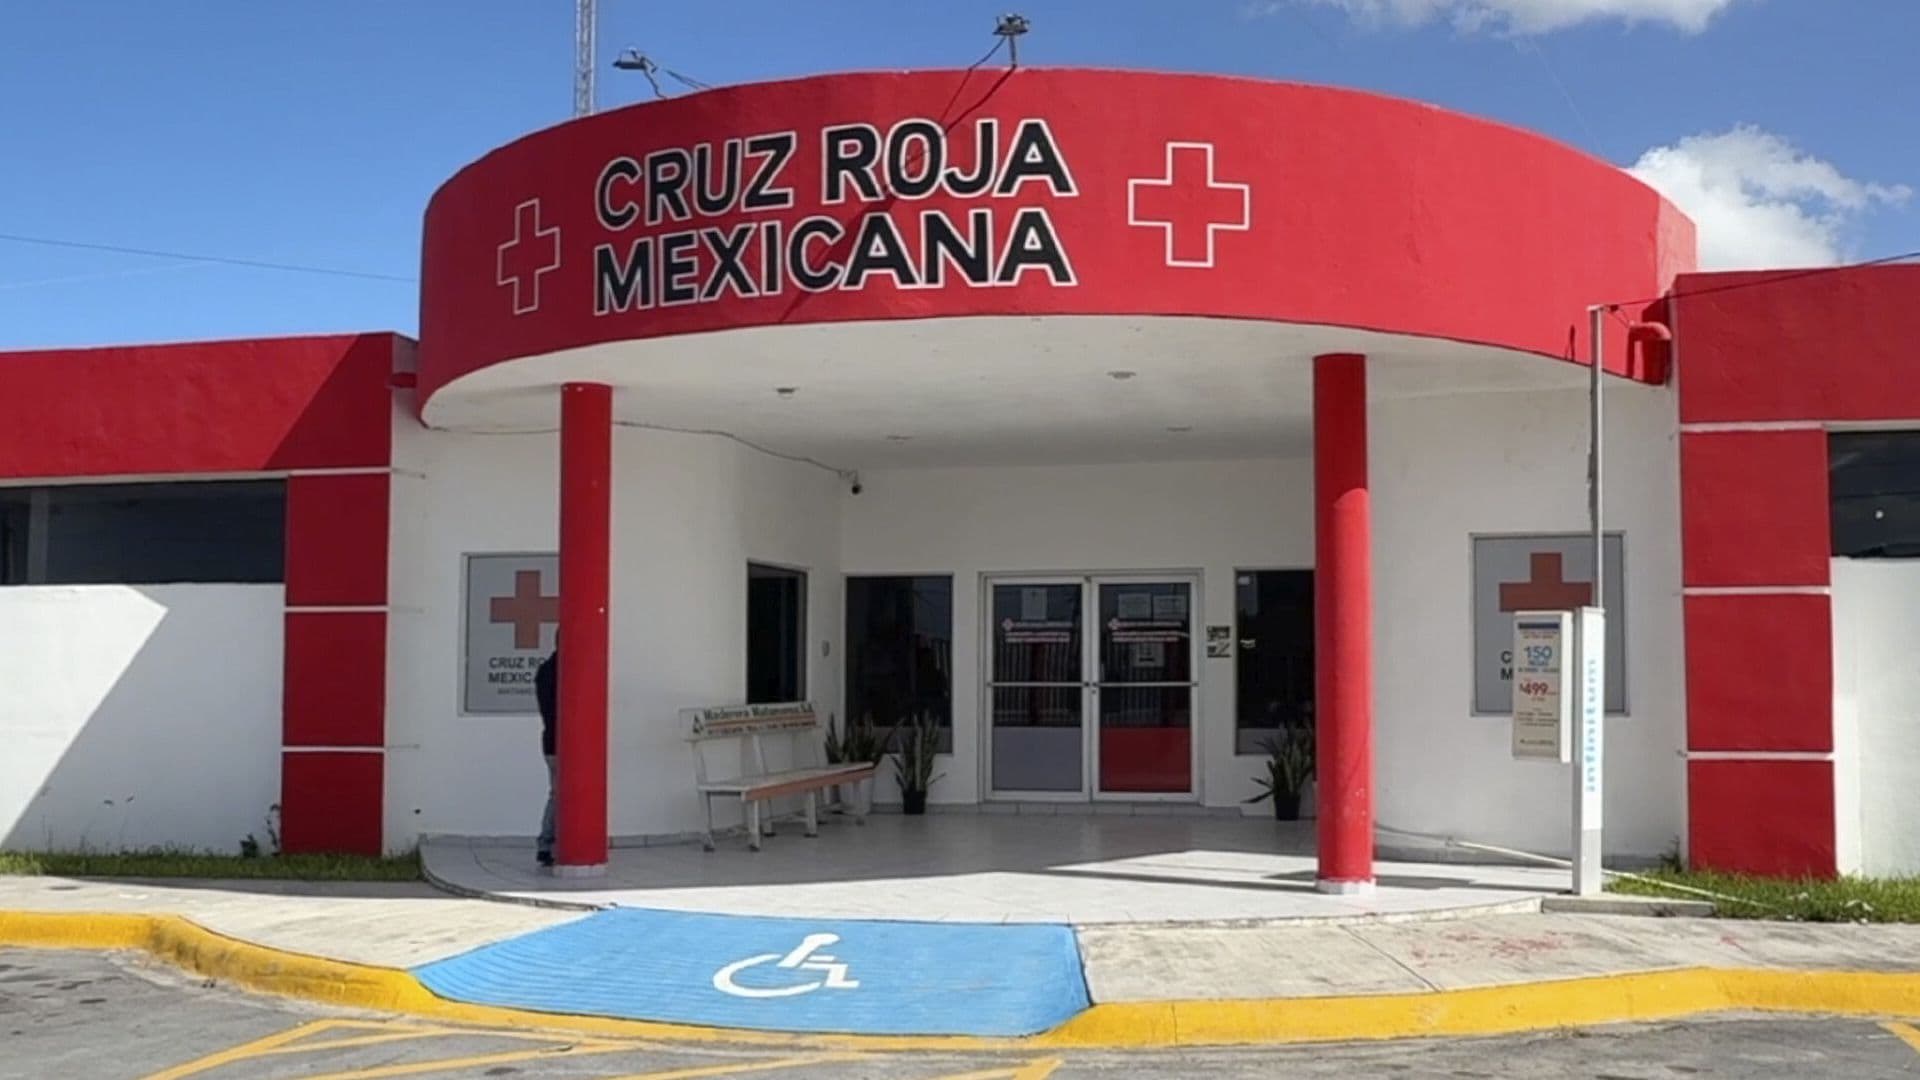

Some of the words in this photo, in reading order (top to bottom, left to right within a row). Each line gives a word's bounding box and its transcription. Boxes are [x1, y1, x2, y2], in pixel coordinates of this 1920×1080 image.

[595, 130, 796, 230] CRUZ
[821, 118, 1079, 205] ROJA
[593, 207, 1079, 316] MEXICANA
[489, 657, 525, 668] CRUZ
